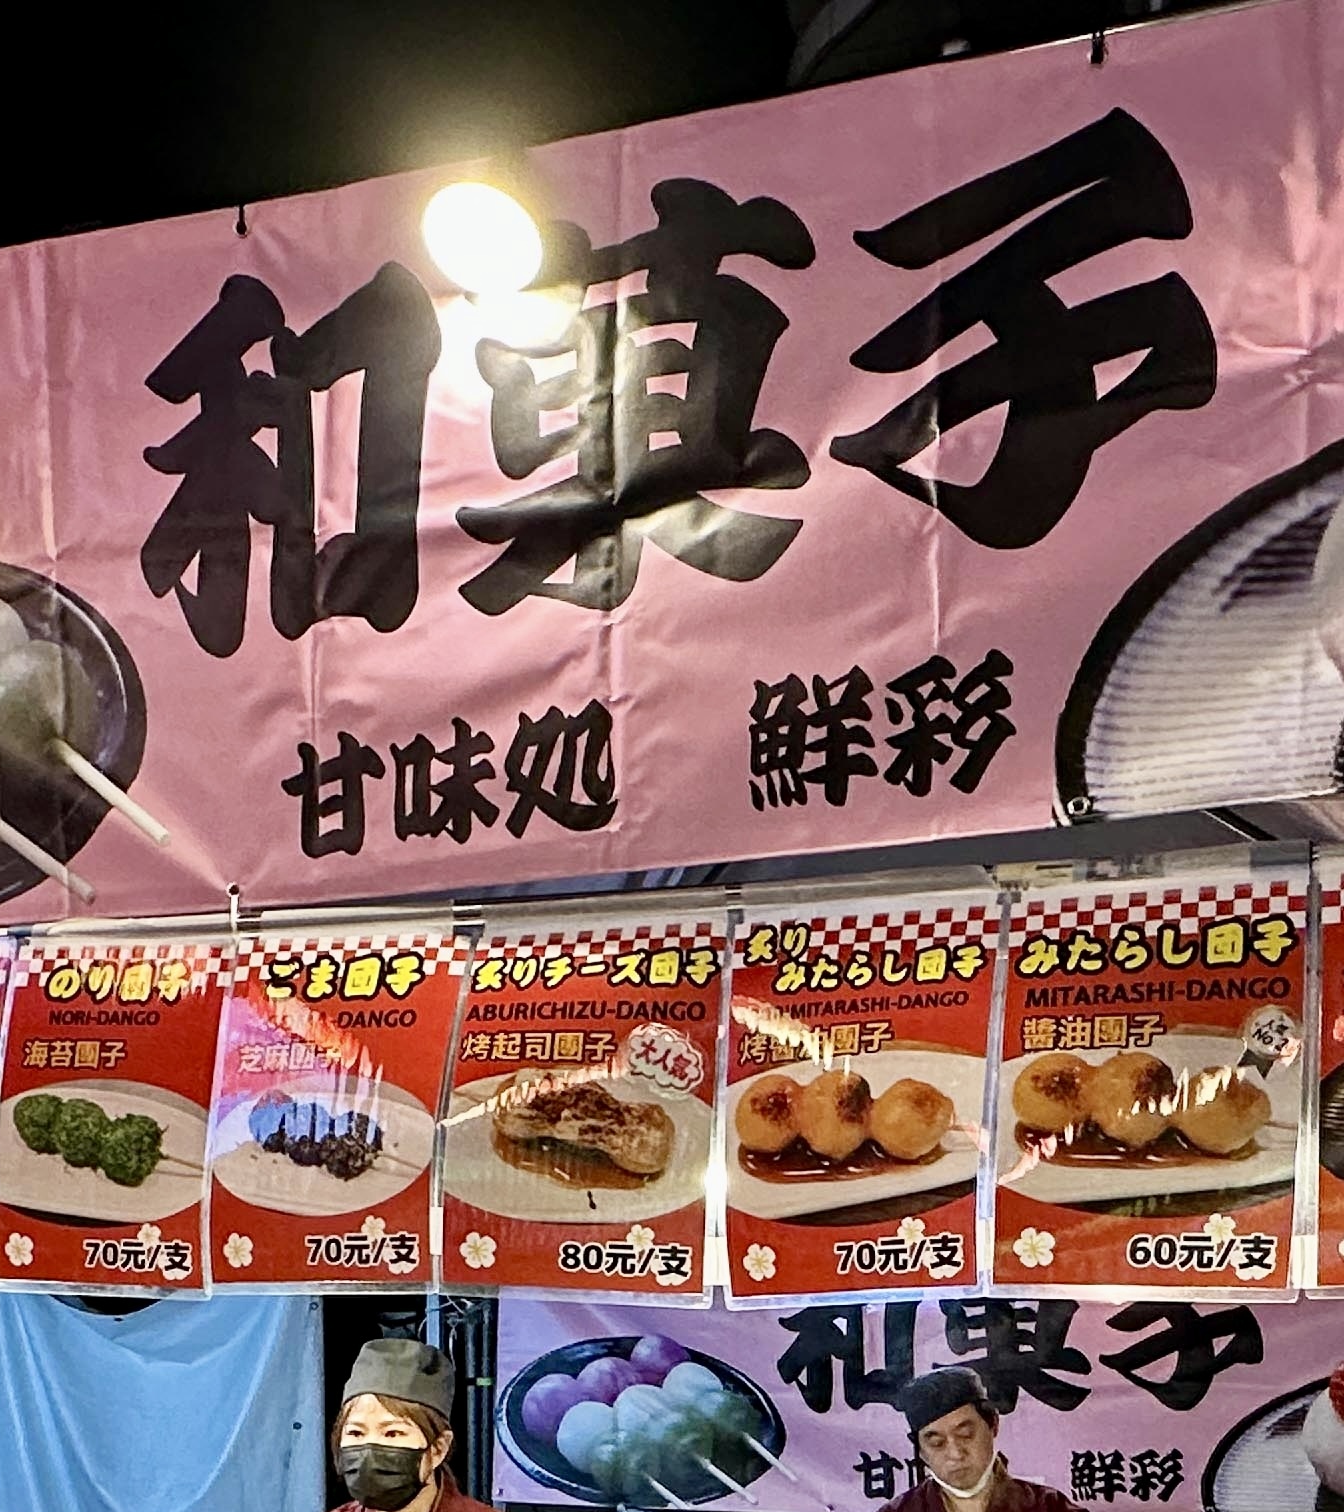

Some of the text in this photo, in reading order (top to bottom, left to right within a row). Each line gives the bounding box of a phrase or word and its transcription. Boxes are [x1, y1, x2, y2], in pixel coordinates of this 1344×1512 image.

[143, 106, 1217, 658] 和菓子
[747, 650, 1017, 814] 鮮彩
[281, 697, 616, 861] 甘味処
[1017, 916, 1297, 977] みたらし団子
[773, 944, 985, 993] みたらし団子
[466, 999, 707, 1022] ABURICHIZU-DANGO
[1025, 976, 1291, 1008] MITARASHI-DANGO
[49, 1010, 161, 1026] NORI-DANGO
[1022, 1014, 1165, 1051] 醬油團子
[22, 1040, 127, 1069] 海苔團子
[460, 1028, 618, 1063] 烤起司團子
[83, 1238, 192, 1272] 70元/支
[305, 1232, 419, 1267] 70元/支
[559, 1239, 692, 1281] 80元/支
[834, 1233, 964, 1275] 70元/支
[1128, 1231, 1276, 1272] 60元/支
[1069, 1450, 1185, 1502] 鮮彩
